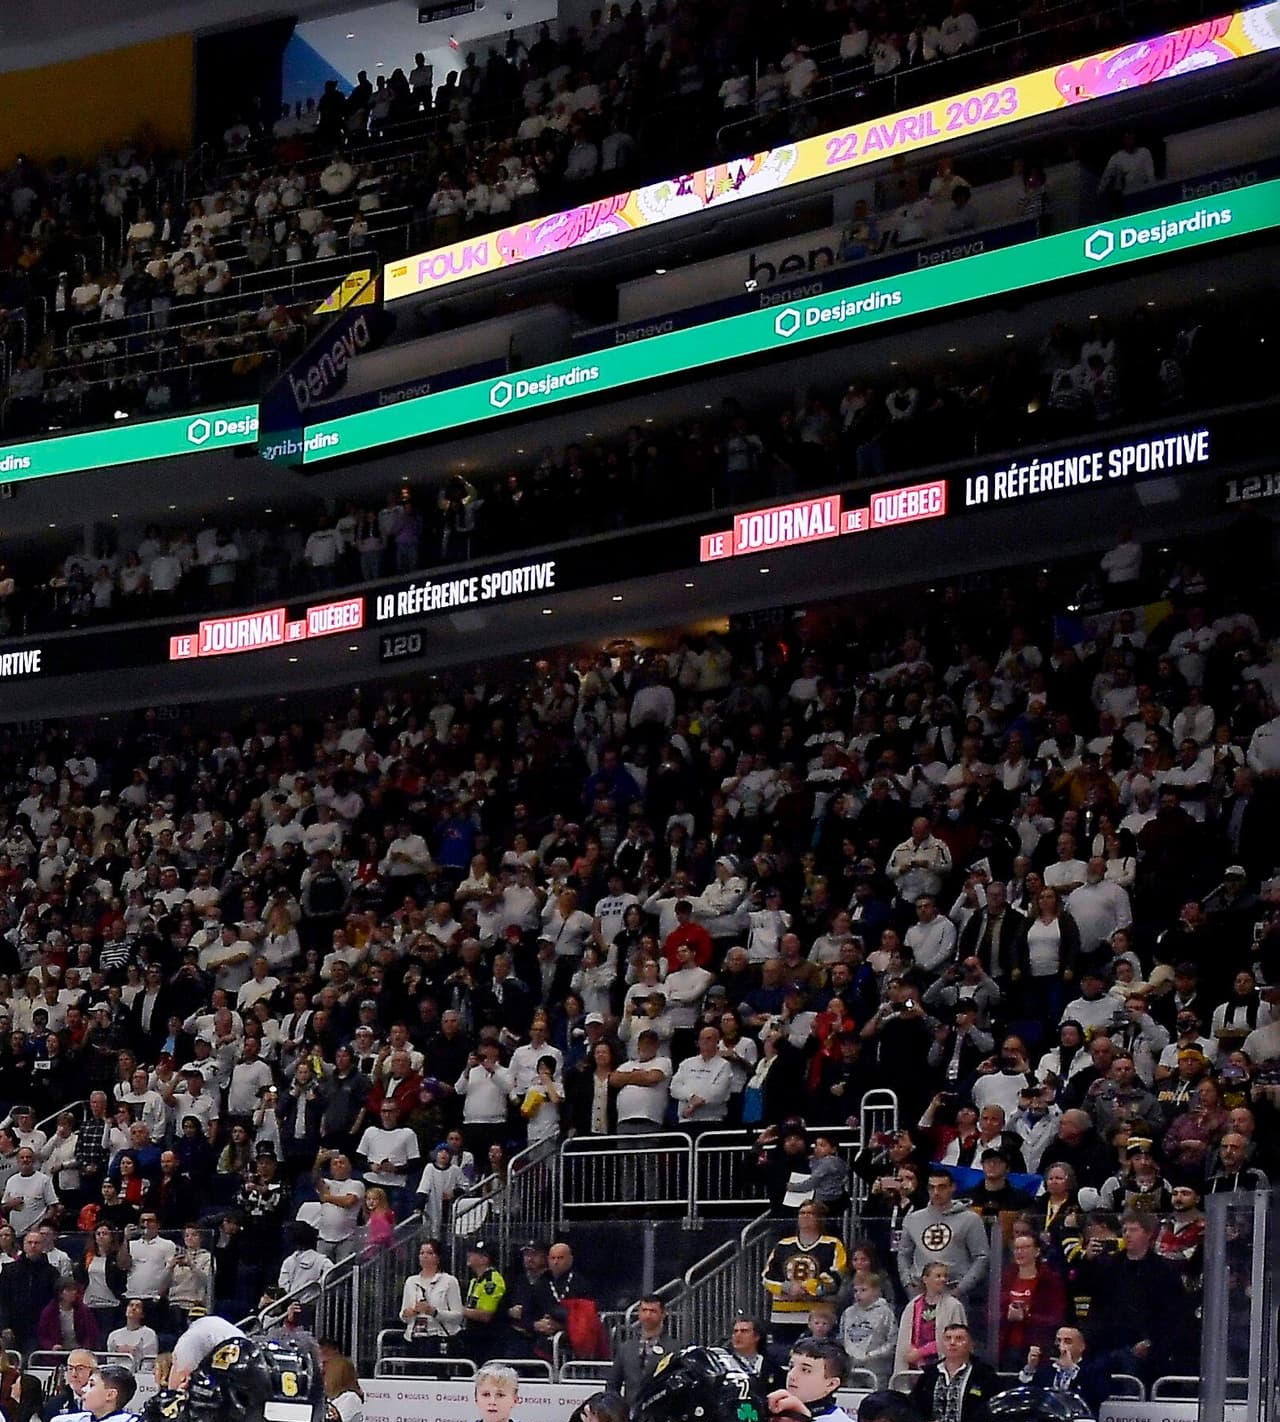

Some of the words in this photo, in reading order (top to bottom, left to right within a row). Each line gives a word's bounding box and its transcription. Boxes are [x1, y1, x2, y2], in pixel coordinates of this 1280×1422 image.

[826, 134, 857, 165] 22
[862, 113, 940, 156] AVRIL
[946, 87, 1018, 132] 2023
[1120, 208, 1231, 249] Desjardins
[417, 241, 488, 285] FOUKI
[917, 240, 984, 267] beneva
[760, 281, 824, 308] beneva
[806, 290, 902, 326] Desjardins
[291, 314, 371, 411] beneva
[515, 366, 599, 399] Desjardins
[966, 475, 988, 506] LA
[994, 452, 1103, 502] RÉFÉRENCE
[1109, 431, 1209, 478] SPORTIVE
[709, 536, 724, 557] LE
[737, 501, 835, 550] JOURNAL
[847, 513, 862, 530] DE
[874, 486, 941, 524] QUÉBEC
[376, 594, 394, 621] LA
[397, 577, 479, 616] RÉFÉRENCE
[481, 561, 556, 601] SPORTIVE
[177, 639, 190, 656] LE
[202, 613, 281, 652] JOURNAL
[290, 625, 300, 638] DE
[309, 603, 360, 633] QUÉBEC
[383, 634, 422, 658] 120
[281, 1371, 299, 1397] 6
